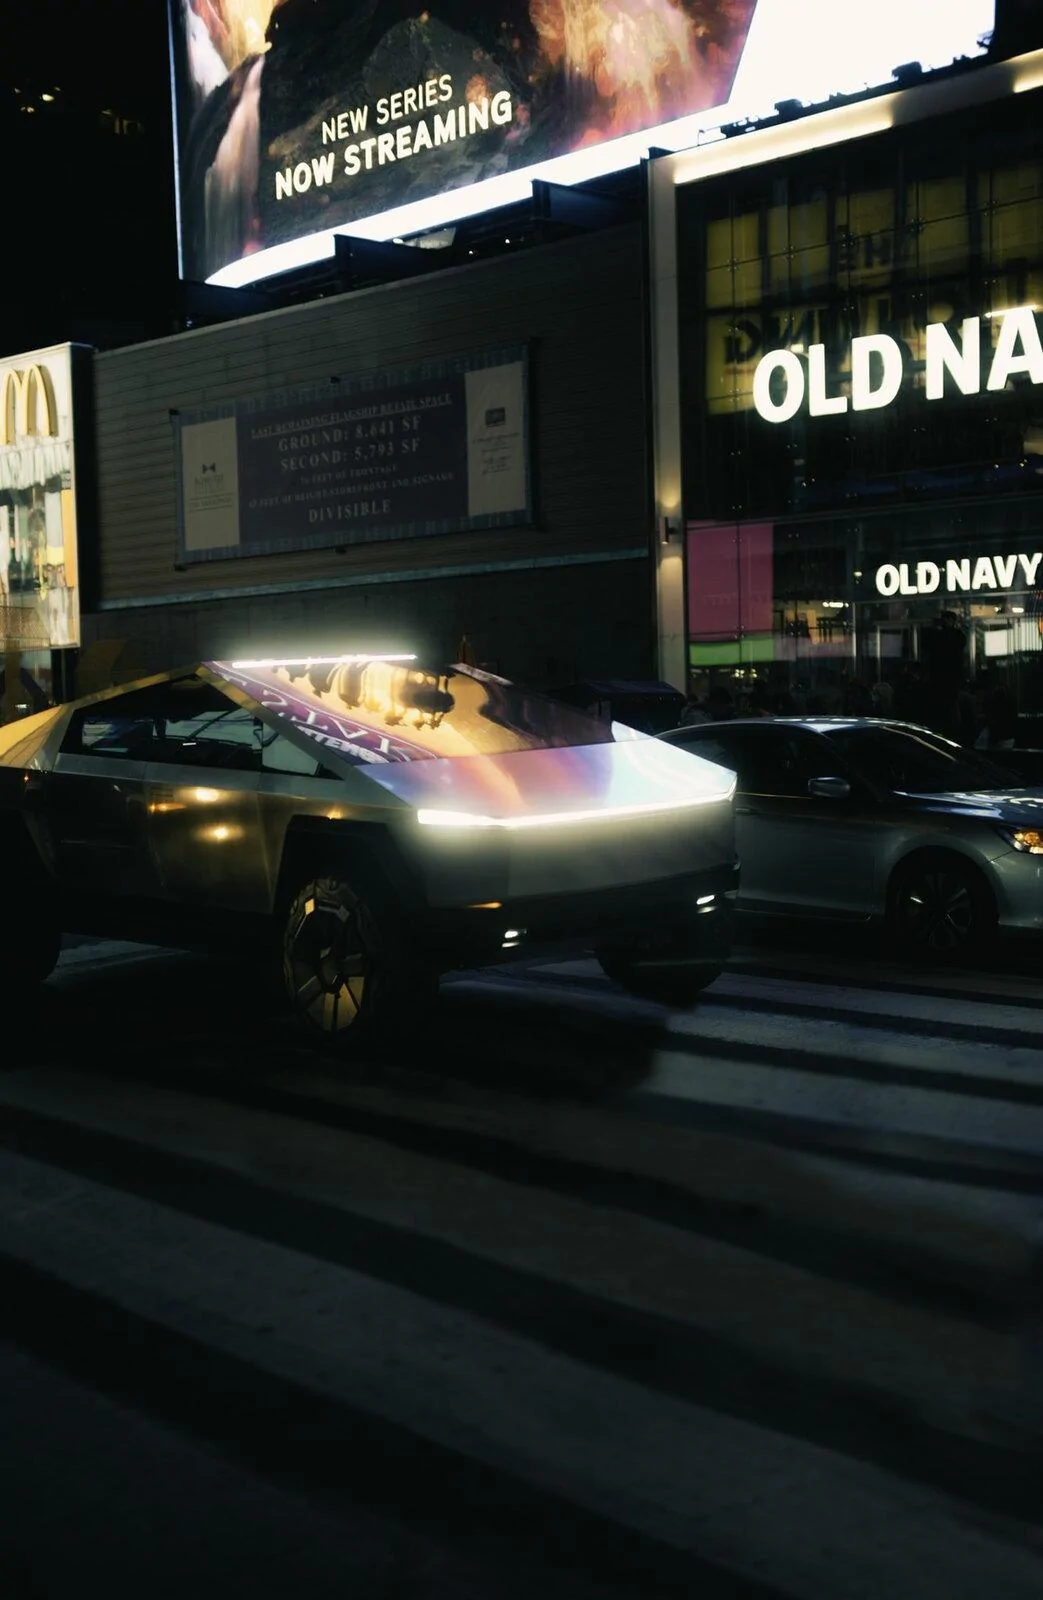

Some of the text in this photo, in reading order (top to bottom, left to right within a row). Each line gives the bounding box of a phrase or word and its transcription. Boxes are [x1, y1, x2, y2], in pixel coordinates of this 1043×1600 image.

[322, 74, 453, 145] NEW SERIES
[275, 90, 513, 200] NOW STREAMING
[753, 333, 903, 423] OLD
[418, 393, 453, 409] SPACE
[278, 429, 349, 452] GROUND:
[402, 415, 422, 432] SF
[280, 449, 349, 473] SECOND:
[402, 437, 421, 454] SF
[309, 499, 391, 523] DIVISIBLE
[876, 552, 1043, 596] OLD NAVY
